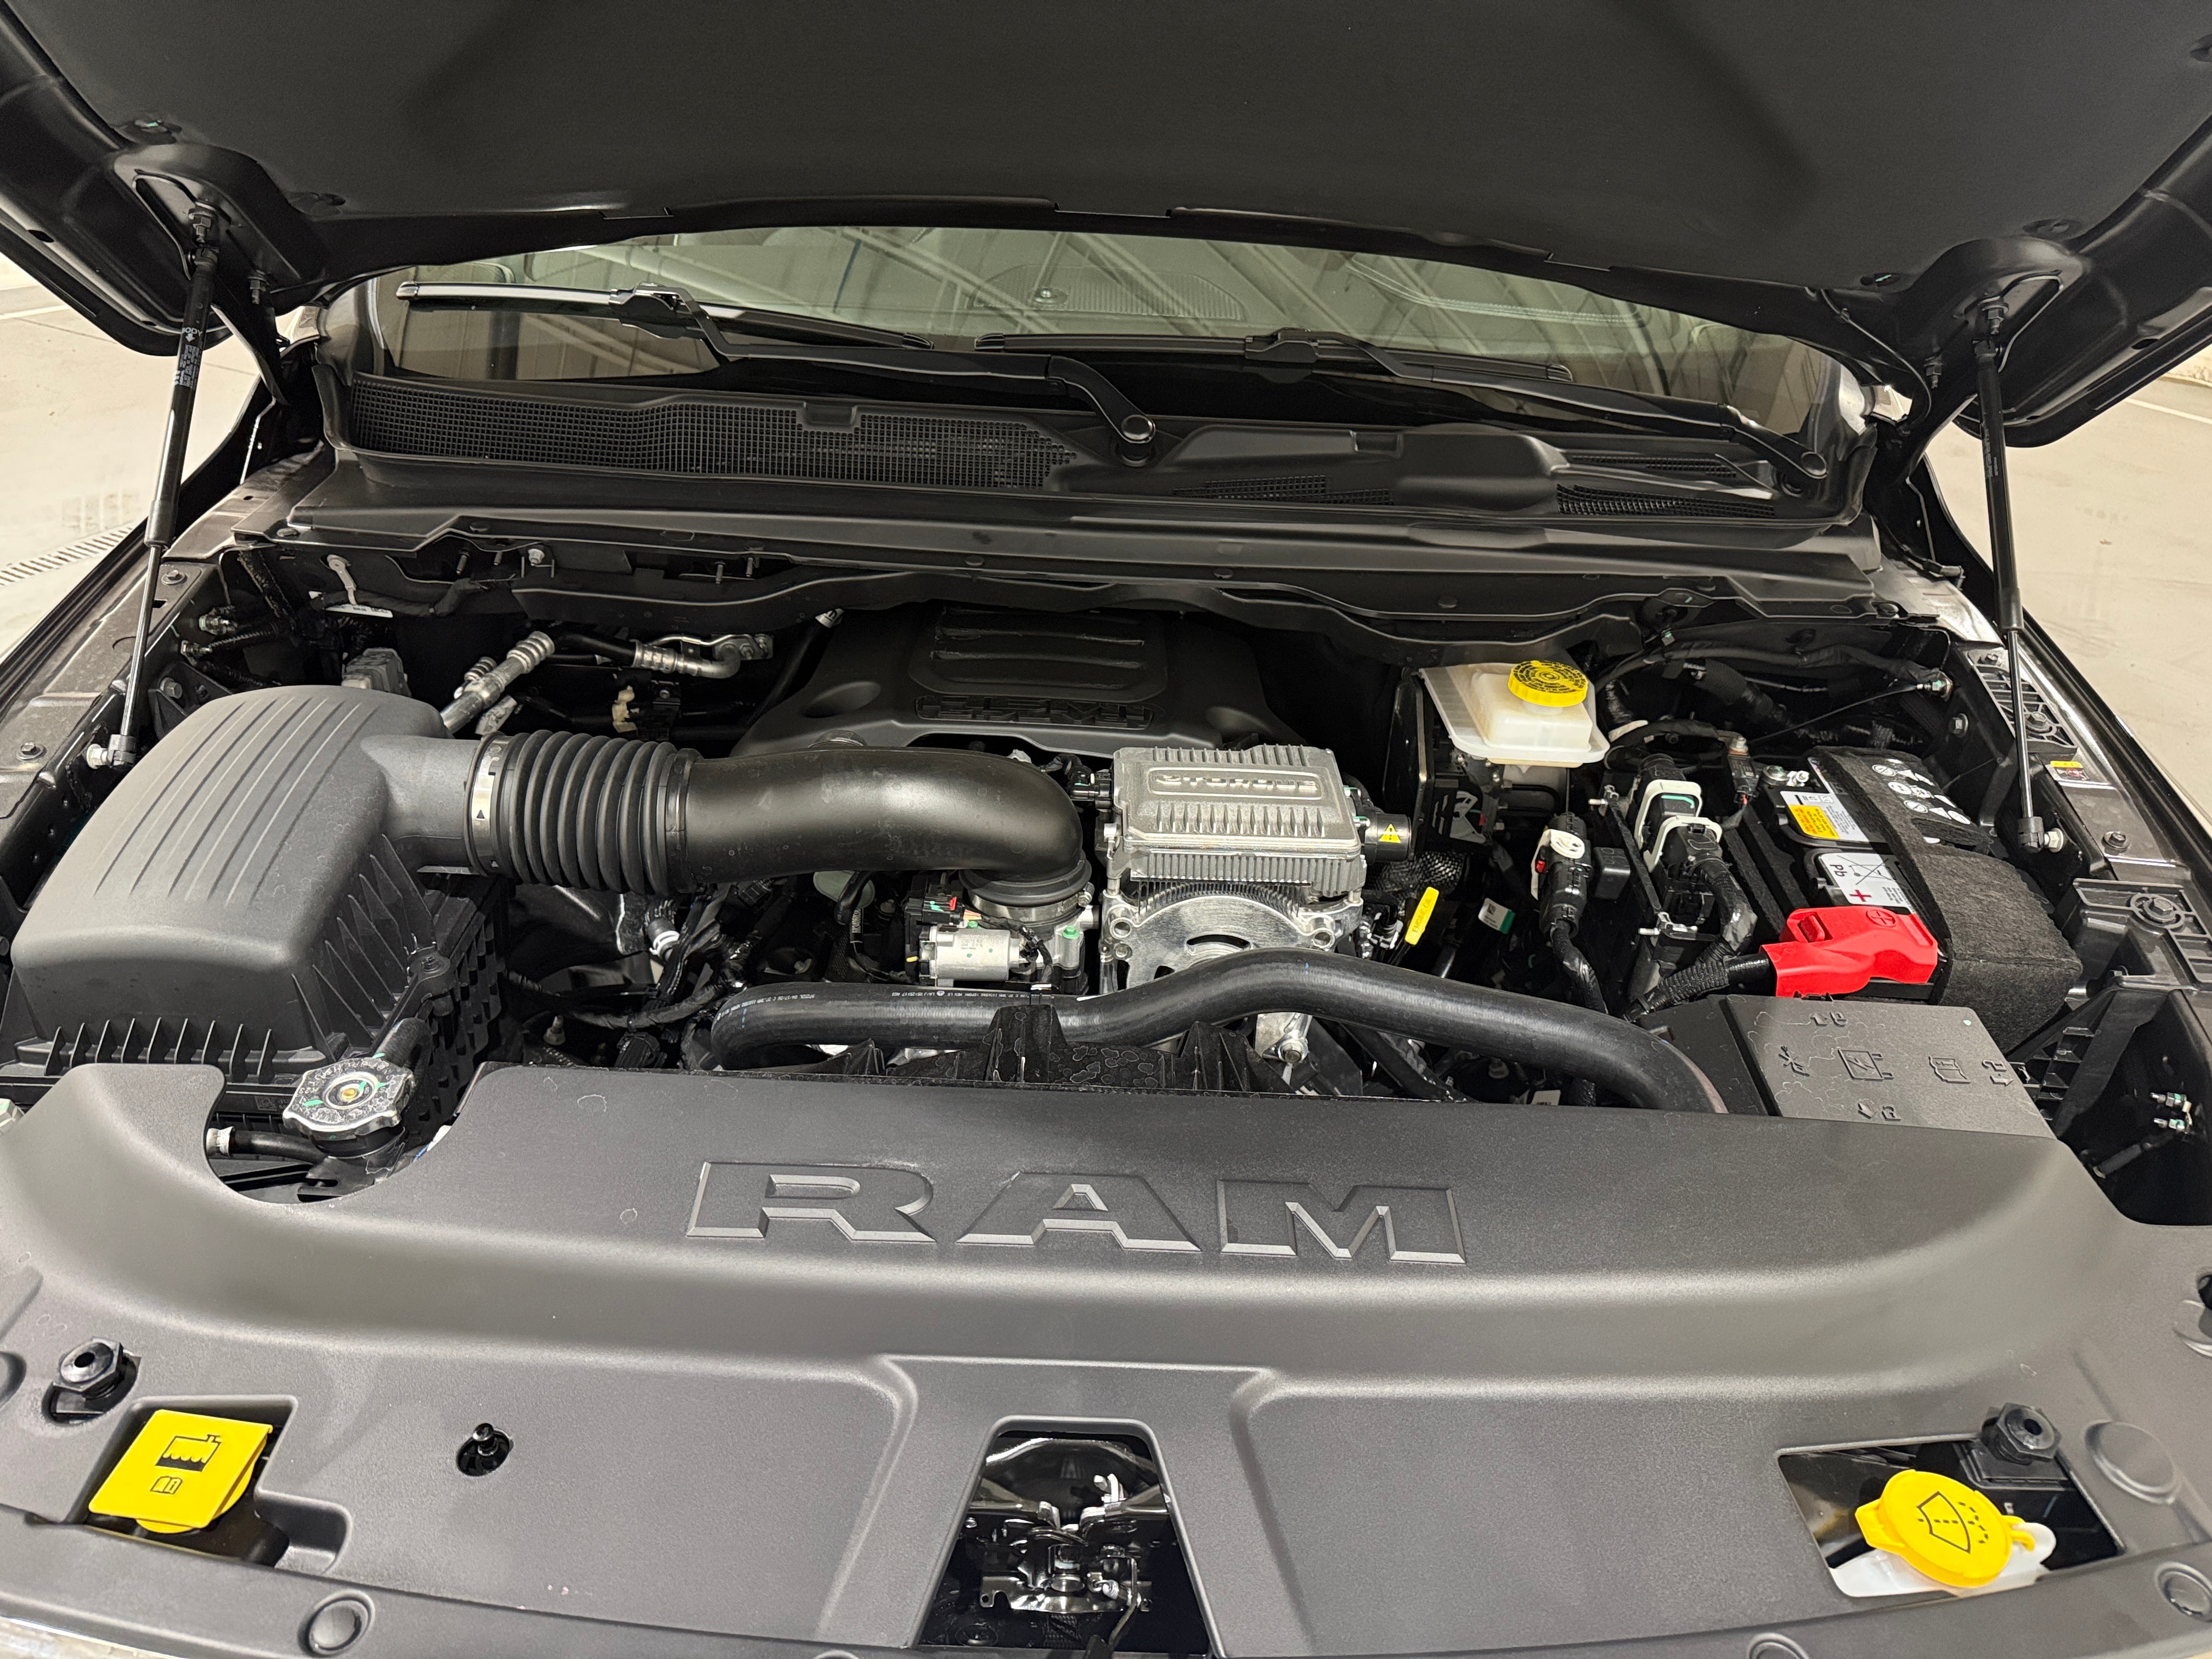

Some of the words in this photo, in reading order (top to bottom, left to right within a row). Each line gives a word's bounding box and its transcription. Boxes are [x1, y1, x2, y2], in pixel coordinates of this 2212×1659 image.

[182, 327, 202, 336] BODY
[1829, 864, 1847, 877] Pb
[686, 1160, 1467, 1264] RAM
